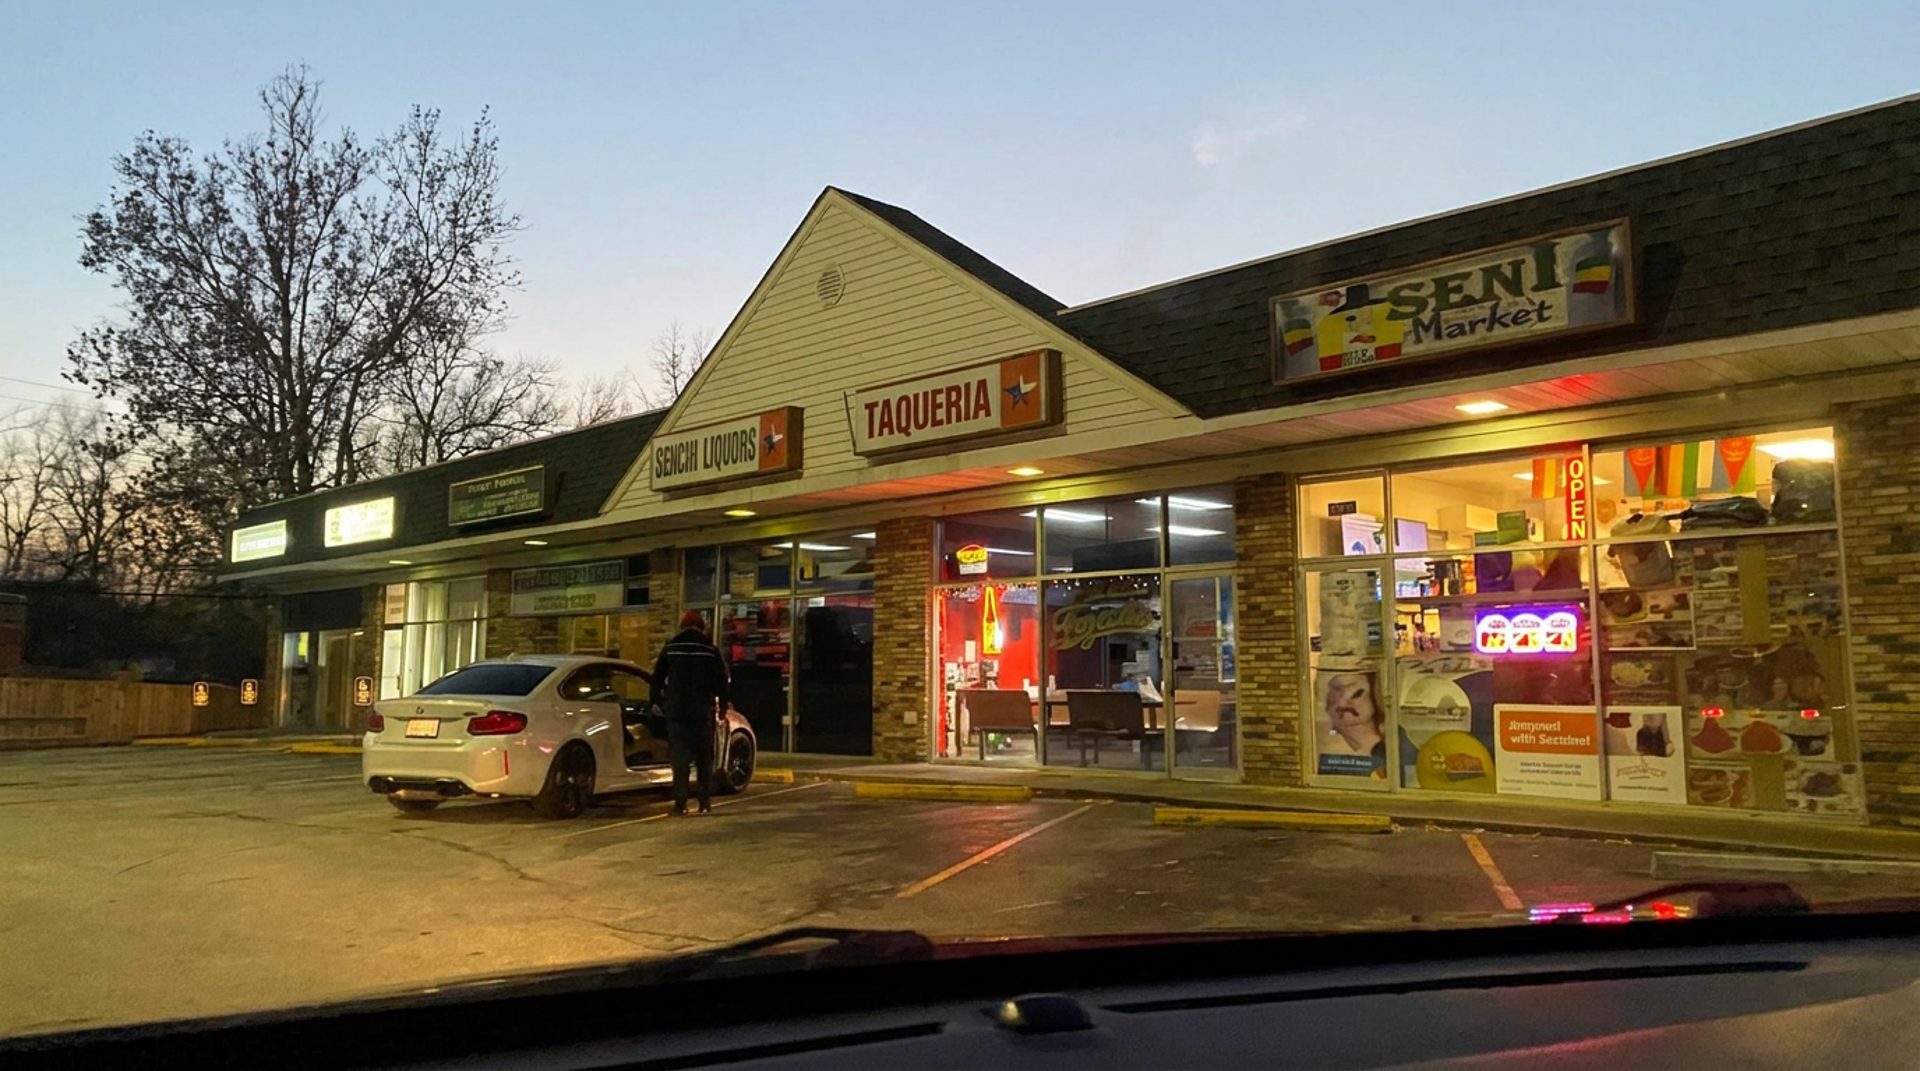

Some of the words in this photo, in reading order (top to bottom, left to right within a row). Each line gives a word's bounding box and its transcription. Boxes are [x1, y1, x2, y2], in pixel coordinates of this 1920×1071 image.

[1385, 241, 1563, 321] SENI
[1412, 301, 1553, 344] Market
[864, 378, 992, 439] TAQUERIA
[703, 426, 757, 471] LIQUORS
[1569, 459, 1586, 540] OPEN
